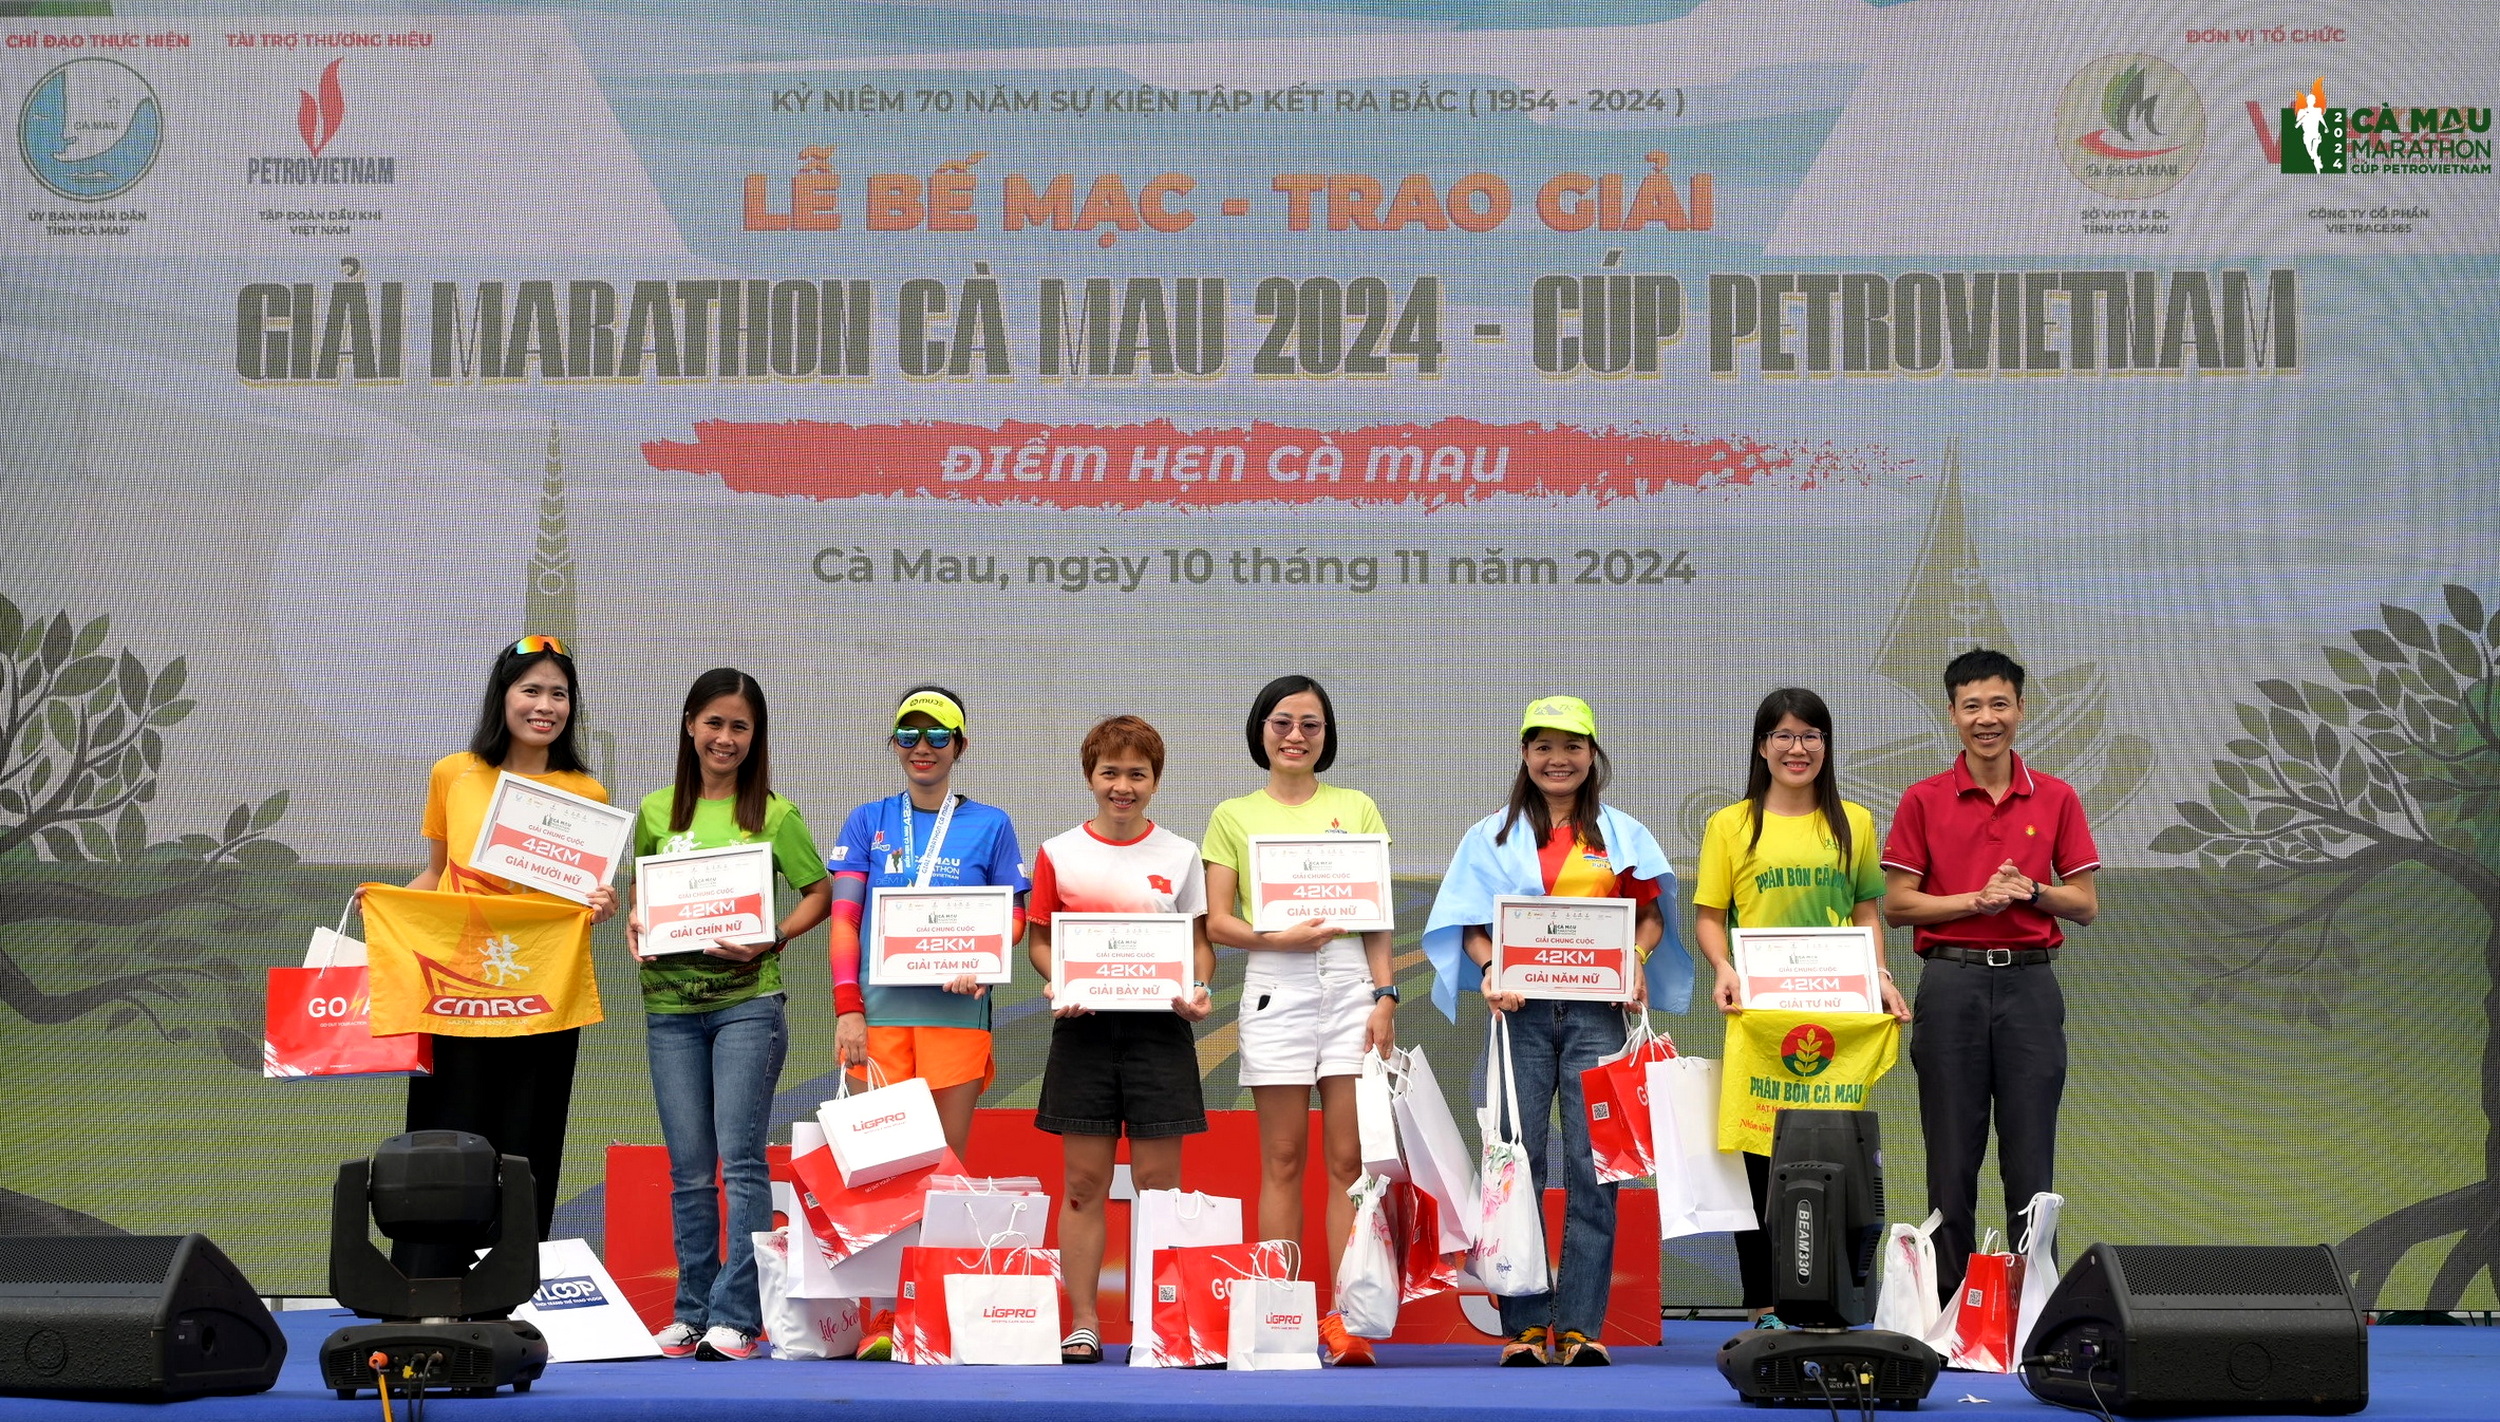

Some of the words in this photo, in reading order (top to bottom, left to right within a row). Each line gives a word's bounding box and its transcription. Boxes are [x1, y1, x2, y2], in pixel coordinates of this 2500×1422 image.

[6, 30, 38, 47] CHỈ
[43, 34, 84, 51] ĐẠO
[90, 34, 139, 50] THỰC
[146, 30, 190, 51] HIỆN
[226, 31, 256, 47] TÀI
[261, 33, 298, 50] TRỢ
[304, 32, 382, 47] THƯƠNG
[388, 30, 433, 50] HIỆU
[2185, 28, 2230, 43] ĐƠN
[2235, 28, 2255, 46] VỊ
[2261, 26, 2285, 43] TỔ
[2291, 26, 2346, 43] CHỨC
[772, 83, 813, 113] KỶ
[823, 84, 903, 118] NIỆM
[917, 90, 954, 113] 70
[965, 85, 1043, 113] NĂM
[1051, 87, 1097, 118] SỰ
[1105, 84, 1179, 118] KIỆN
[1193, 84, 1253, 118] TẬP
[1264, 81, 1324, 113] KẾT
[1335, 90, 1380, 113] RA
[1395, 82, 1459, 113] BẮC
[1487, 90, 1559, 113] 1954
[1588, 90, 1666, 113] 2024
[248, 157, 395, 185] PETROVIETNAM
[743, 145, 842, 232] LỄ
[866, 151, 990, 232] BẾ
[1003, 173, 1197, 249] MẠC
[1272, 173, 1514, 233] TRAO
[1535, 150, 1716, 233] GIẢI
[50, 211, 76, 222] BAN
[80, 207, 117, 222] NHÂN
[120, 207, 147, 222] DÂN
[2351, 208, 2366, 220] TY
[100, 225, 130, 236] MAU
[321, 225, 351, 236] NAM
[2138, 224, 2170, 235] MAU
[237, 257, 405, 385] GIẢI
[431, 279, 874, 384] MARATHON
[898, 262, 1016, 382] CÀ
[1039, 277, 1230, 382] MAU
[1252, 276, 1448, 381] 2024
[1532, 250, 1686, 379] CÚP
[1709, 269, 2300, 379] PETROVIETNAM
[940, 430, 1110, 483] ĐIỂM
[1267, 436, 1345, 483] CÀ
[1365, 445, 1511, 483] MAU
[812, 546, 875, 585] Cà
[892, 548, 1011, 591] Mau,
[1027, 546, 1152, 593] ngày
[1163, 548, 1214, 584] 10
[1229, 546, 1379, 594] tháng
[1394, 548, 1430, 584] 11
[1447, 546, 1559, 585] năm
[1574, 548, 1697, 585] 2024
[522, 838, 582, 866] 42KM
[505, 855, 529, 870] GIẢI
[531, 862, 562, 880] MƯỜI
[563, 873, 583, 886] NỮ
[1755, 866, 1785, 894] PHÂN
[1787, 864, 1811, 887] BÓN
[1814, 864, 1830, 887] CÀ
[1292, 884, 1352, 898] 42KM
[678, 900, 736, 919] 42KM
[1287, 905, 1311, 917] GIẢI
[1313, 905, 1337, 916] SÁU
[1340, 905, 1357, 916] NỮ
[670, 925, 692, 939] GIẢI
[695, 922, 723, 936] CHÍN
[726, 920, 743, 933] NỮ
[915, 937, 976, 952] 42KM
[907, 958, 931, 970] GIẢI
[933, 958, 959, 969] TÁM
[961, 958, 980, 969] NỮ
[1534, 949, 1595, 965] 42KM
[1096, 963, 1157, 977] 42KM
[1524, 971, 1549, 983] GIẢI
[1551, 972, 1579, 984] NĂM
[1582, 972, 1600, 985] NỮ
[1089, 983, 1113, 995] GIẢI
[1142, 983, 1160, 995] NỮ
[1780, 978, 1841, 991] 42KM
[307, 997, 347, 1018] GO
[432, 997, 542, 1016] CMRC
[1779, 998, 1803, 1009] GIẢI
[1805, 998, 1821, 1008] TƯ
[1824, 997, 1841, 1008] NỮ
[1749, 1076, 1780, 1101] PHÂN
[1784, 1079, 1810, 1104] BÓN
[1814, 1081, 1831, 1104] CÀ
[1834, 1084, 1863, 1104] MAU
[1798, 1209, 1810, 1277] BEAM330
[532, 1280, 596, 1302] VLOOP
